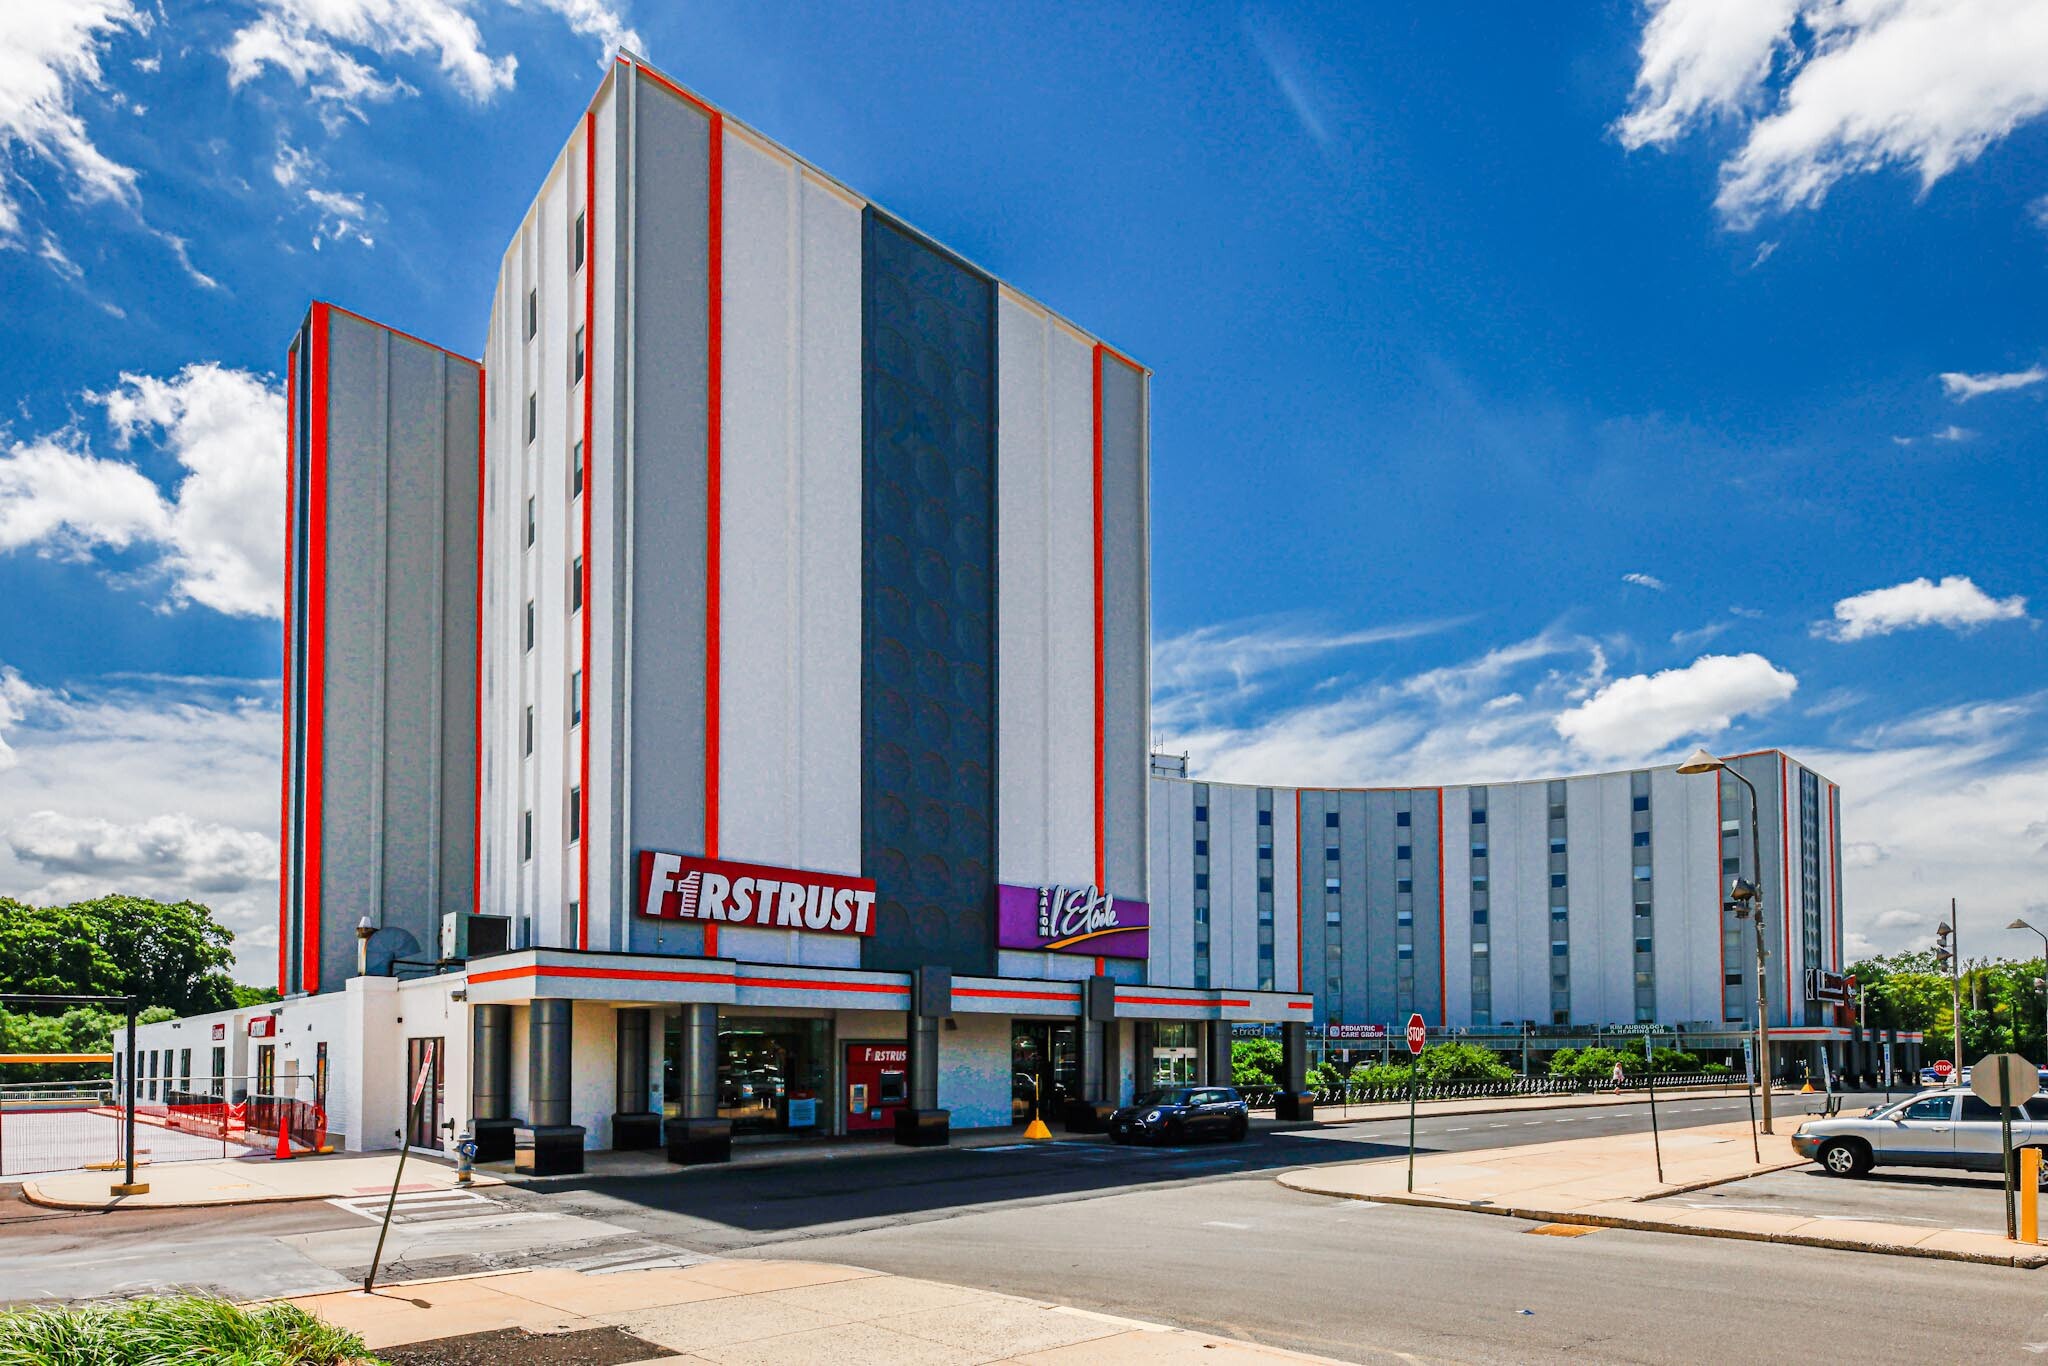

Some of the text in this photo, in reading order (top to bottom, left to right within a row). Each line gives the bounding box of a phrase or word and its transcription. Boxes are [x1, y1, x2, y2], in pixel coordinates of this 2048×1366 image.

[1039, 887, 1049, 937] SALON
[1240, 1027, 1261, 1036] bridal
[1408, 1026, 1424, 1041] STOP
[1935, 1064, 1952, 1072] STOP
